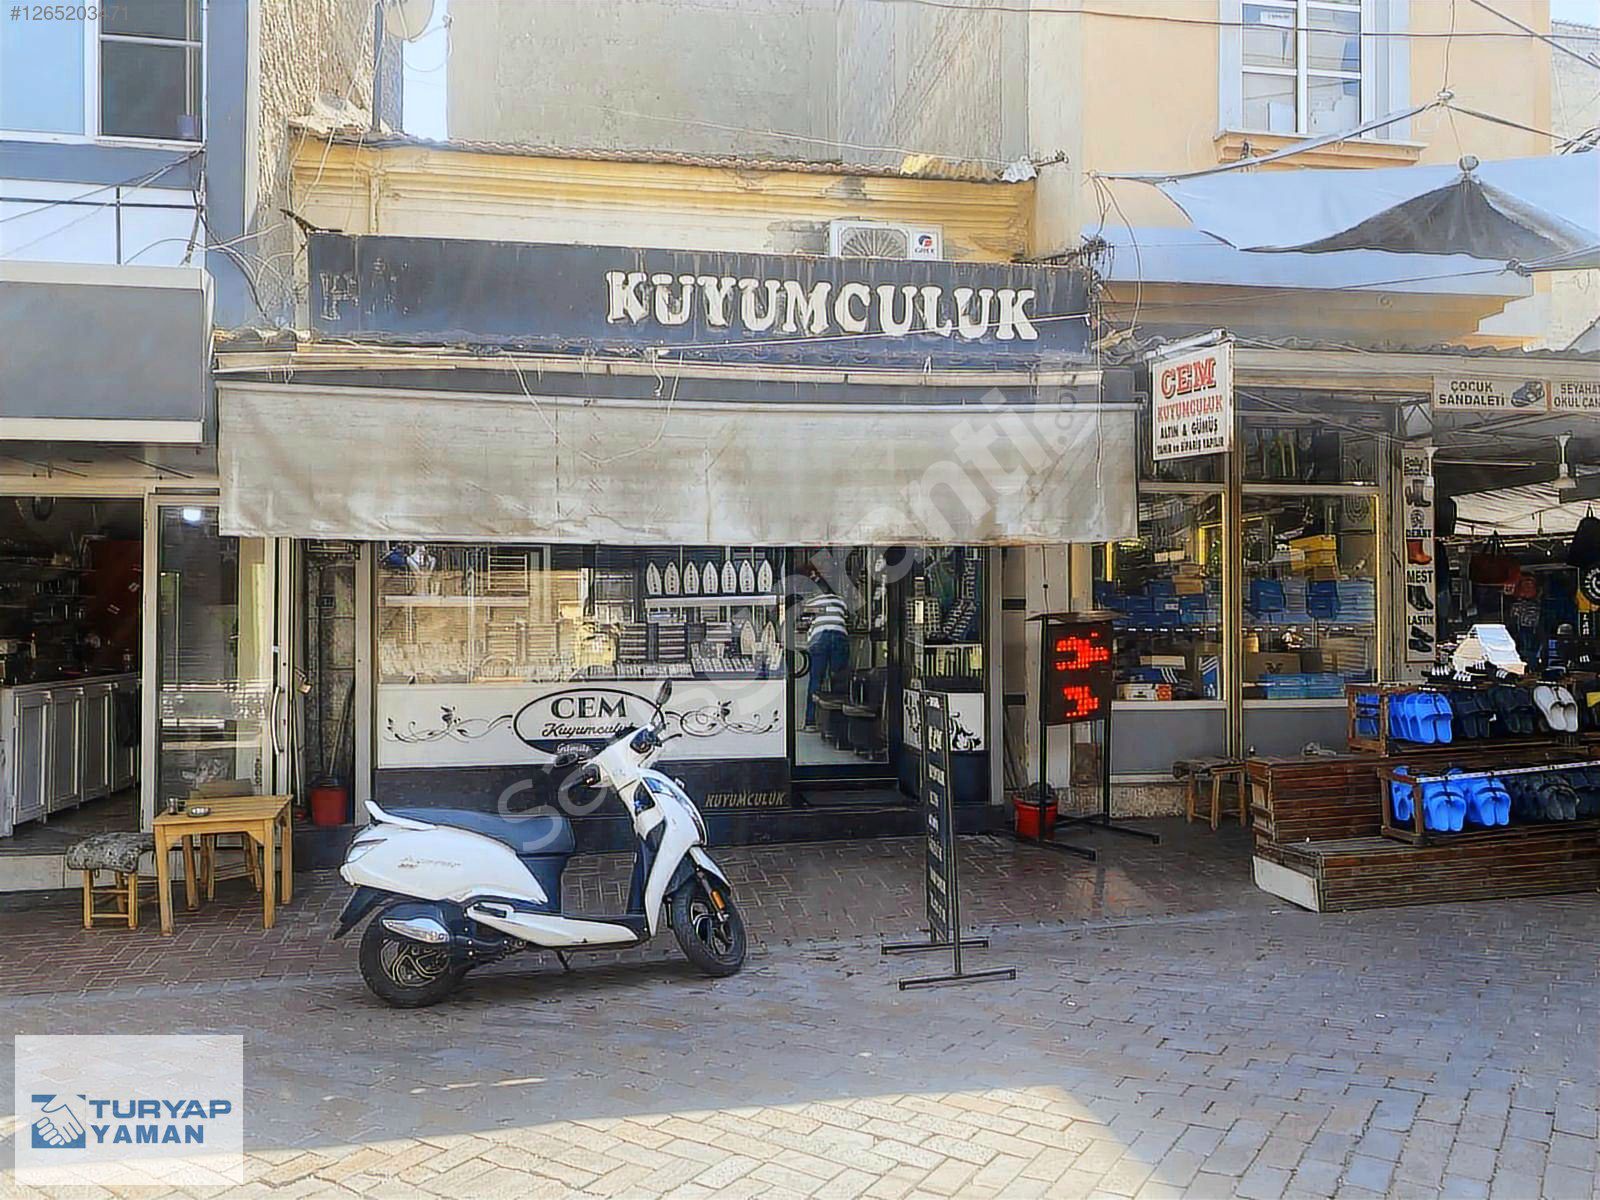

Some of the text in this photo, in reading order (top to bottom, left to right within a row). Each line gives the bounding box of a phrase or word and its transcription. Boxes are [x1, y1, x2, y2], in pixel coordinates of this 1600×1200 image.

[606, 271, 1038, 340] KUYUMCULUK
[1161, 357, 1216, 399] CEM
[1451, 381, 1493, 394] ÇOCUK
[1439, 392, 1505, 406] SANDALETİ
[1554, 396, 1580, 407] OKUL
[1157, 394, 1223, 422] KUYUMCULUK
[1407, 570, 1433, 583] MEST
[551, 697, 627, 718] CEM
[705, 791, 786, 807] KUYUMCULUK
